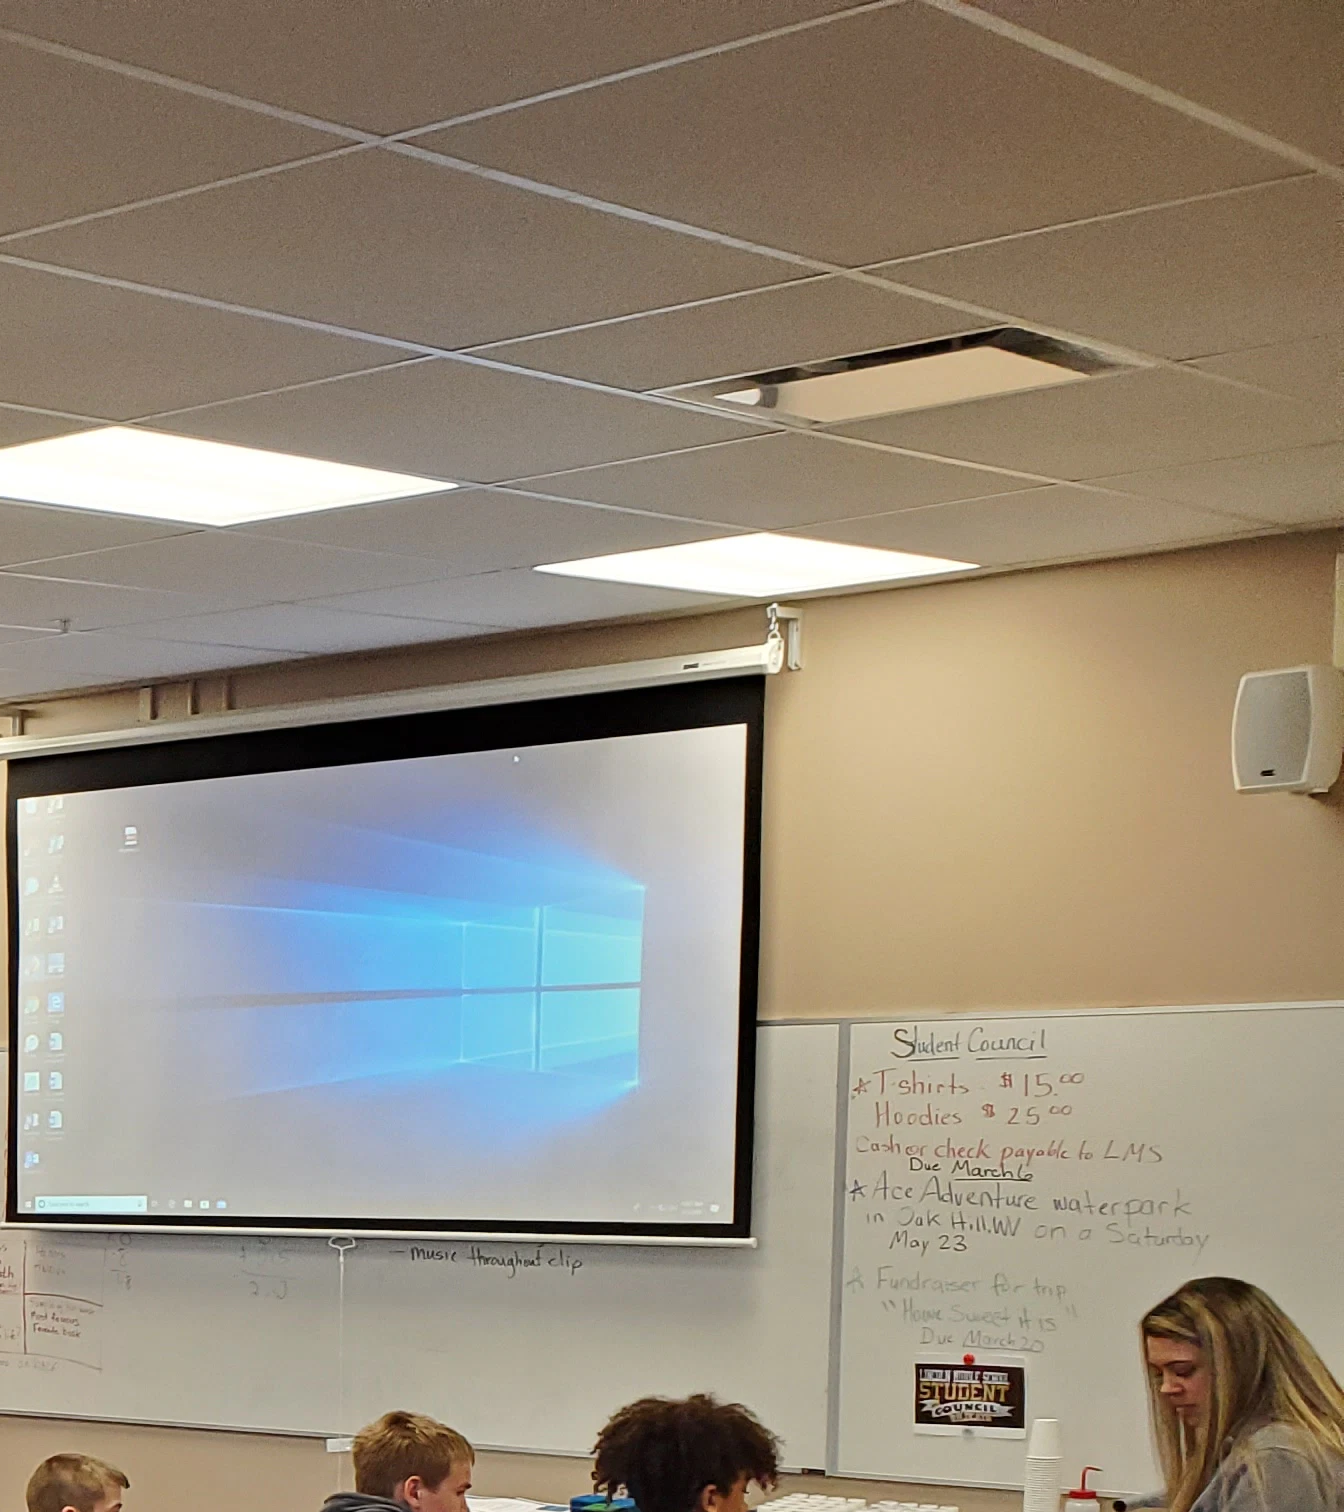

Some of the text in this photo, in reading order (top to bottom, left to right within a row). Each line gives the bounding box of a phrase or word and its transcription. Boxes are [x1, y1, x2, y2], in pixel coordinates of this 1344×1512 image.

[890, 1025, 1046, 1059] Student Council
[875, 1100, 963, 1129] Hoodies
[909, 1156, 942, 1172] Due
[951, 1159, 1013, 1180] March
[934, 1137, 991, 1160] check
[1001, 1139, 1069, 1171] payable
[1079, 1140, 1094, 1160] to
[872, 1169, 913, 1201] Ace
[919, 1174, 1039, 1211] Adventure
[865, 1211, 885, 1225] in
[1034, 1224, 1067, 1241] on
[888, 1229, 968, 1257] May 23
[547, 1248, 583, 1276] clip
[991, 1272, 1027, 1297] for
[919, 1326, 954, 1345] Due
[963, 1329, 1017, 1348] March
[919, 1381, 1011, 1404] STUDENT
[934, 1403, 998, 1416] COUNCIL
